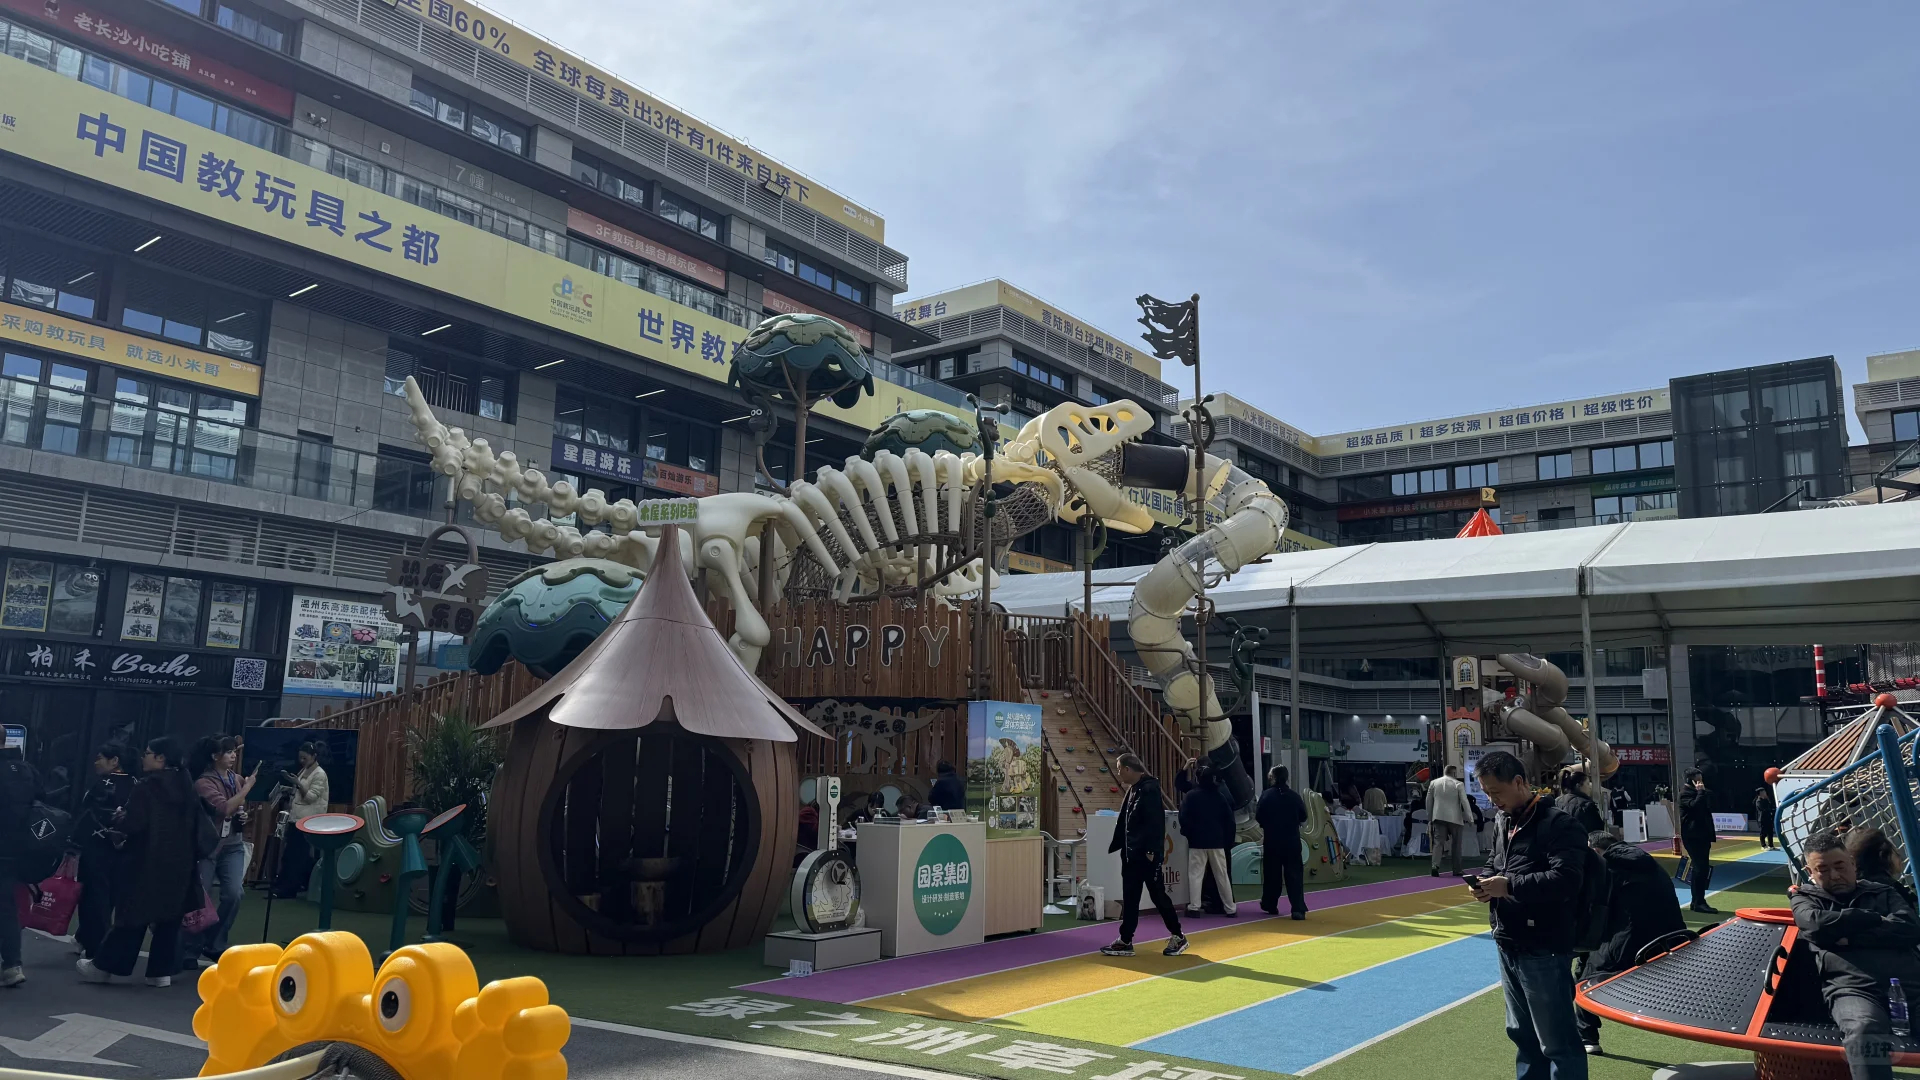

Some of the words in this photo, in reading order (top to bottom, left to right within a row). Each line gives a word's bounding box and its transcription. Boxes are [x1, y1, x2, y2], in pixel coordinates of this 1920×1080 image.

[73, 12, 192, 72] 老长沙小吃铺
[76, 112, 441, 267] 中国教玩具之都
[595, 223, 698, 274] 3F教玩具综合展示区
[1, 313, 106, 351] 采购教玩具
[125, 343, 221, 378] 就选小米哥
[1042, 308, 1134, 366] 壹陆捌台球棋牌会所
[640, 502, 698, 521] 木屋系列B款
[111, 652, 201, 677] Baihe
[776, 624, 949, 668] HAPPY
[918, 861, 969, 889] 园景集团
[1162, 866, 1181, 883] ihe
